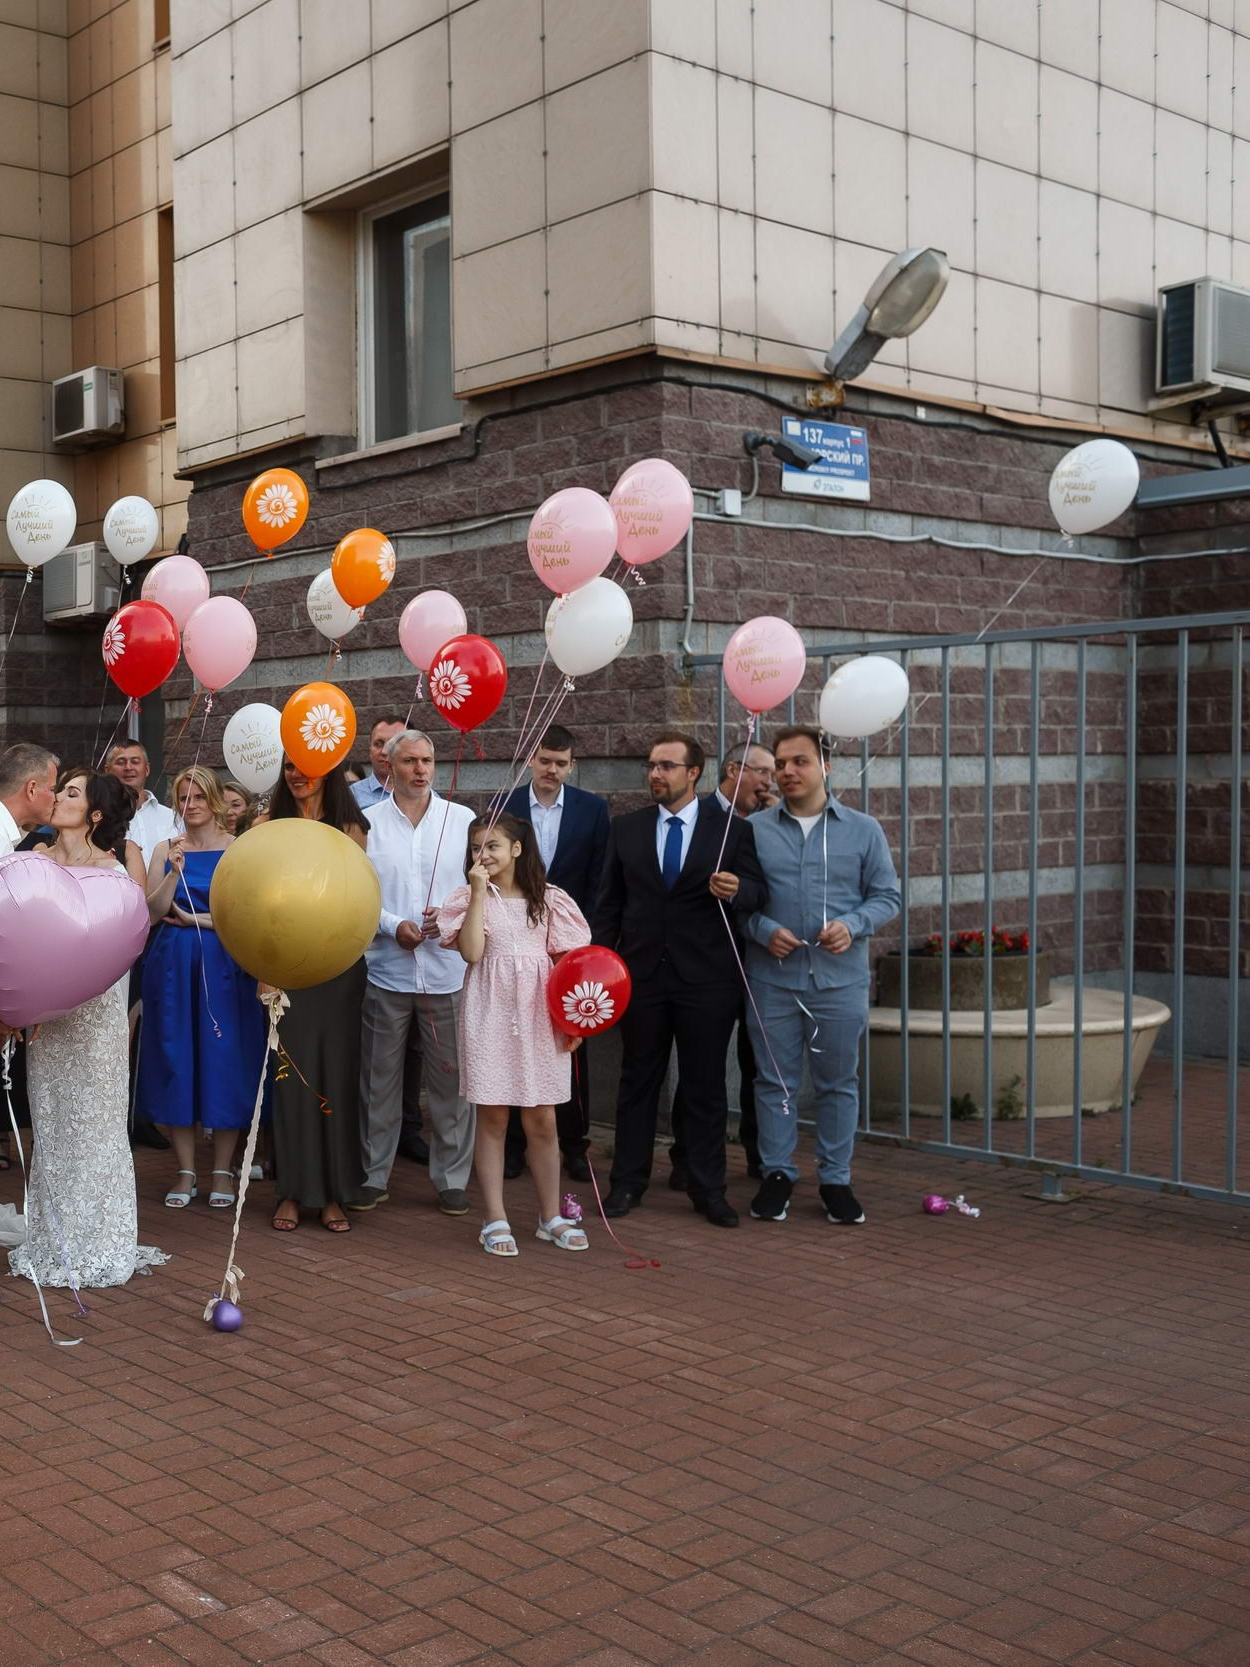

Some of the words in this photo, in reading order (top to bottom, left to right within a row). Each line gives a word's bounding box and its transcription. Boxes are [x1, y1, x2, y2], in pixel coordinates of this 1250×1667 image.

[803, 427, 823, 444] 137
[846, 437, 851, 449] 1
[1063, 491, 1091, 506] День
[11, 510, 40, 520] Самый
[15, 519, 53, 533] Лучший
[627, 522, 659, 538] День
[27, 531, 52, 544] День
[126, 536, 145, 546] День
[542, 555, 570, 570] День
[750, 669, 780, 685] День
[231, 737, 262, 754] Самый
[240, 744, 278, 764] Лучший
[255, 757, 278, 774] День
